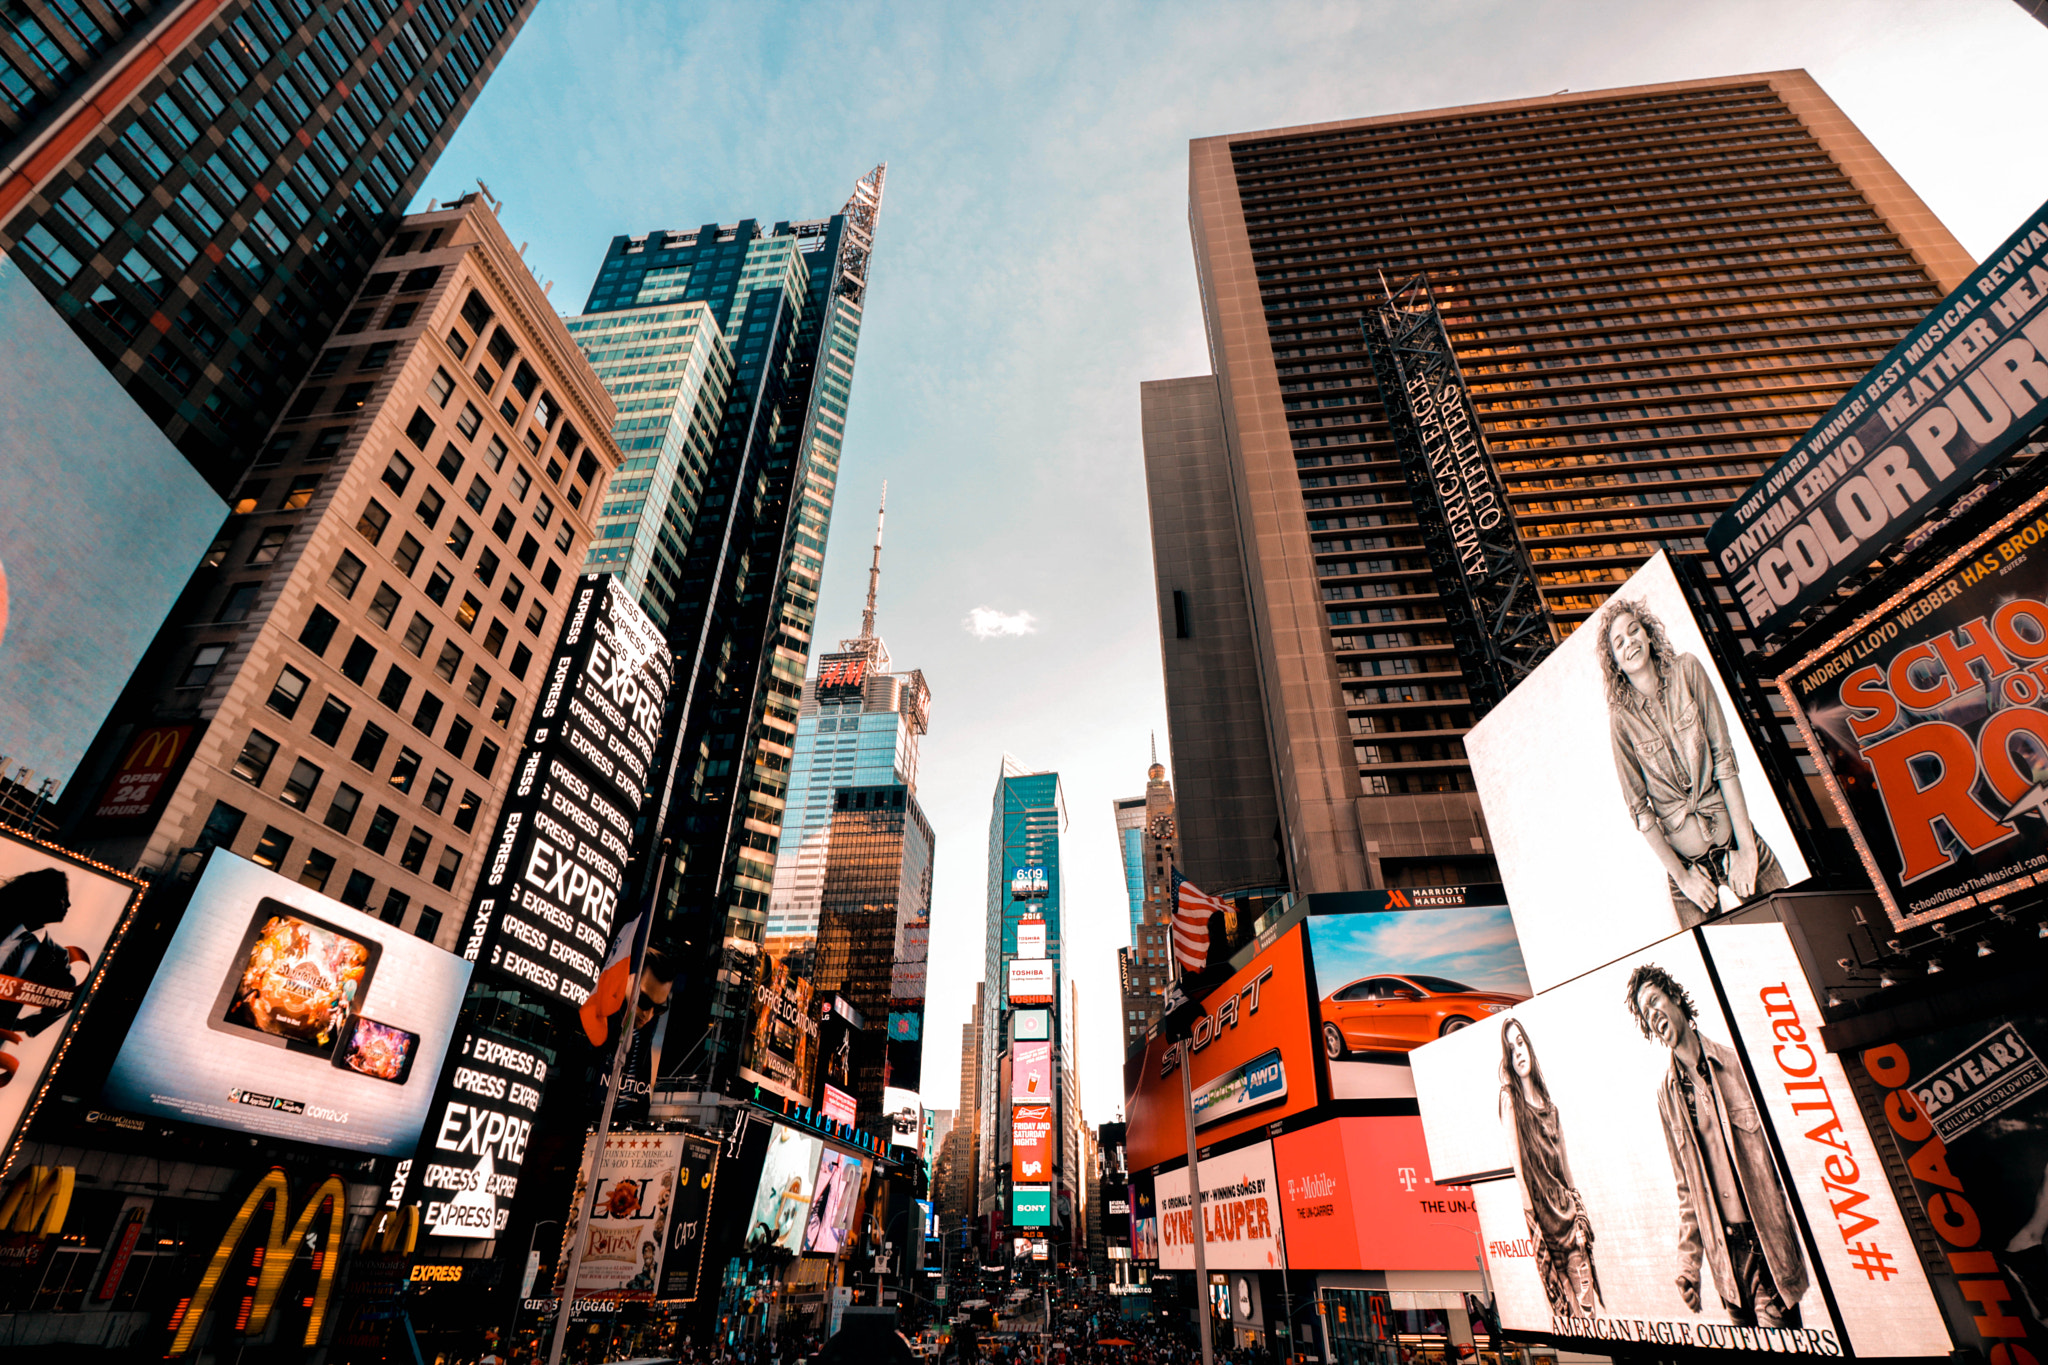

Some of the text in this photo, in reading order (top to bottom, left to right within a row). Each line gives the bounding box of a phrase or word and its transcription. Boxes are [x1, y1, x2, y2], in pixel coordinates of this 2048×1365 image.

[1719, 253, 2048, 575] CYNTHIA ERIVO HEATHER HEA
[1734, 490, 1766, 525] TONY
[1765, 450, 1810, 500] AWARD
[1809, 392, 1869, 461] WINNER!
[1867, 357, 1906, 402] BEST
[1904, 294, 1980, 366] MUSICAL
[1406, 372, 1488, 576] AMERICAN EAGLE
[1438, 384, 1500, 530] OUTFITTERS
[1756, 443, 1931, 608] COLOR
[1913, 486, 1990, 546] OUTRONT
[2000, 554, 2028, 576] REUTERS
[566, 588, 594, 644] EXPRESS
[1734, 564, 1778, 630] THE
[609, 606, 646, 655] EXPRESS
[1800, 650, 1854, 696] ANDREW
[1852, 620, 1899, 658] LLOYD
[1897, 578, 1962, 629] WEBBER
[1960, 553, 2000, 587] HAS
[542, 656, 572, 718] EXPRESS
[630, 659, 662, 704] EXPRESS
[820, 660, 866, 688] H&M
[584, 683, 626, 731] EXPRESS
[586, 640, 661, 753] EXPRE
[570, 729, 614, 776] EXPRESS
[608, 734, 644, 778] EXPRESS
[112, 785, 150, 803] 24
[119, 773, 162, 784] OPEN
[96, 804, 150, 816] HOURS
[552, 792, 599, 836] EXPRESS
[590, 793, 629, 836] EXPRESS
[488, 812, 522, 886] EXPRESS
[576, 842, 618, 883] EXPRESS
[525, 838, 618, 938] EXPRE
[1016, 868, 1043, 880] 6:09
[1413, 887, 1466, 896] MARRIOTT
[1909, 854, 2048, 914] SchoolOfRockTheMusical.com
[522, 890, 574, 932] EXPRESS
[1415, 896, 1463, 905] MARQUIS
[464, 899, 495, 963] EXPRE
[503, 951, 558, 990] EXPRESS
[550, 939, 594, 977] EXPRESS
[16, 992, 64, 1008] JANUARY
[21, 982, 74, 1000] SEE IT BEFORE
[758, 985, 817, 1038] OFFICE LOCATIONS
[1010, 995, 1052, 1004] TOSHIBA
[473, 1038, 534, 1076] EXPRESS
[768, 1056, 796, 1080] VORNADO
[1250, 1063, 1278, 1088] AWD
[1918, 1034, 2024, 1114] 20 YEARS
[508, 1082, 540, 1112] EXPRE
[600, 1073, 651, 1094] NUTICA
[1944, 1070, 2038, 1132] KILLING IT WORLDWIDE
[436, 1101, 534, 1165] EXPRE
[783, 1097, 822, 1128] 1540
[825, 1114, 892, 1157] BROADWAY
[1014, 1130, 1046, 1138] SATURDAY
[1014, 1138, 1037, 1146] NIGHTS
[1760, 982, 1898, 1282] #WeAllCan
[604, 1150, 641, 1158] FUNNIEST
[643, 1150, 673, 1158] MUSICAL
[611, 1159, 628, 1168] 400
[1168, 1195, 1188, 1209] ORIGINAL
[1236, 1180, 1256, 1197] SONGS
[1258, 1178, 1266, 1193] BY
[1296, 1204, 1334, 1219] THE UN-CARRIER
[1420, 1200, 1446, 1213] THE
[424, 1201, 492, 1228] EXPRESS
[674, 1220, 697, 1250] CATS
[1164, 1198, 1272, 1246] CYN LAUPER
[0, 1245, 38, 1259] onald's
[410, 1265, 463, 1282] EXPRESS
[570, 1300, 623, 1312] UGGAG
[1552, 1316, 1843, 1357] AMERICAN EAGLE OUTFITTERS
